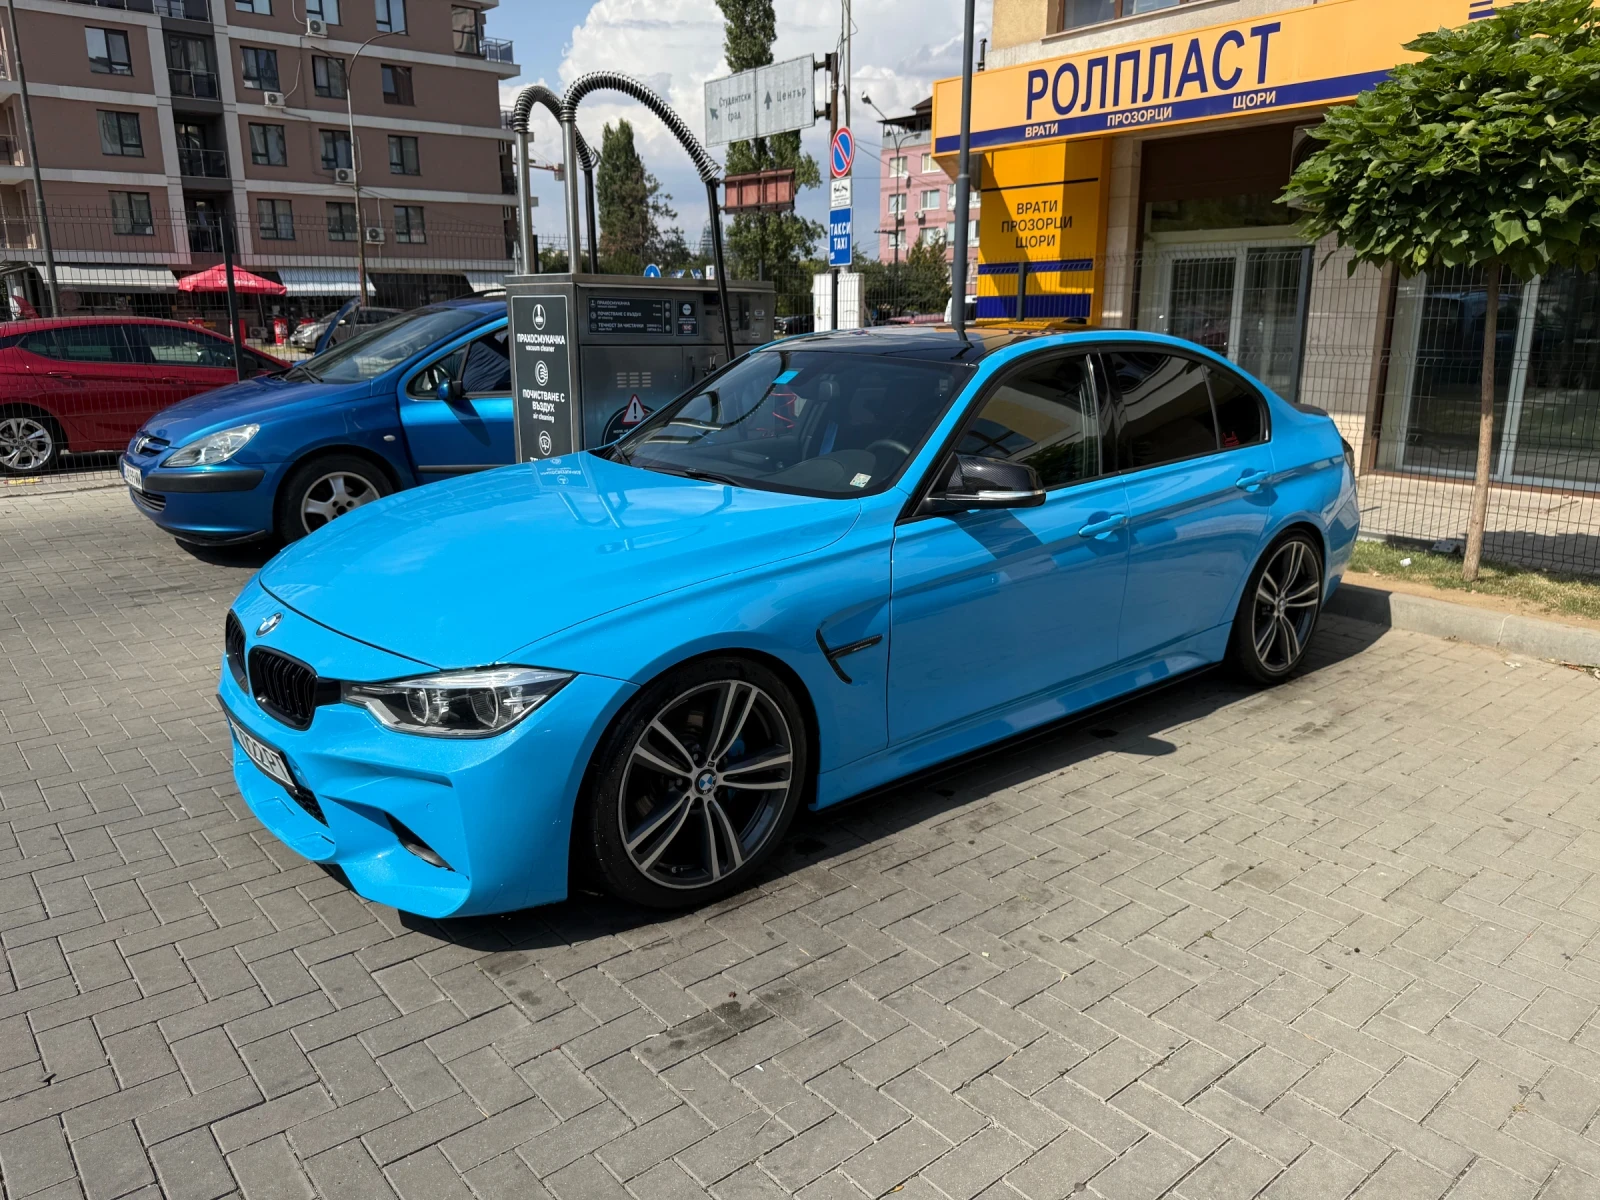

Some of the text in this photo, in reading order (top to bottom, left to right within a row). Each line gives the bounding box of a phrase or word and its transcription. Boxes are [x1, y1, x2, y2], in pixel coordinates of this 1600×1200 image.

[1026, 22, 1281, 120] РОЛПЛАСТ
[718, 92, 752, 108] Студентски
[776, 87, 807, 102] Център
[1025, 91, 1277, 138] ВРАТИ ПРОЗОРЦИ ЩОРИ
[1016, 200, 1059, 215] ВРАТИ
[830, 221, 851, 237] ТАКСИ
[1001, 215, 1074, 233] ПРОЗОРЦИ
[833, 236, 848, 251] TAXI
[1015, 234, 1056, 250] ЩОРИ
[516, 333, 566, 345] ПРАХОСМУКАЧКА
[522, 389, 565, 403] ПОЧИСТВАНЕ С
[532, 401, 555, 413] ВЪЗДУХ
[539, 413, 555, 424] cleaning
